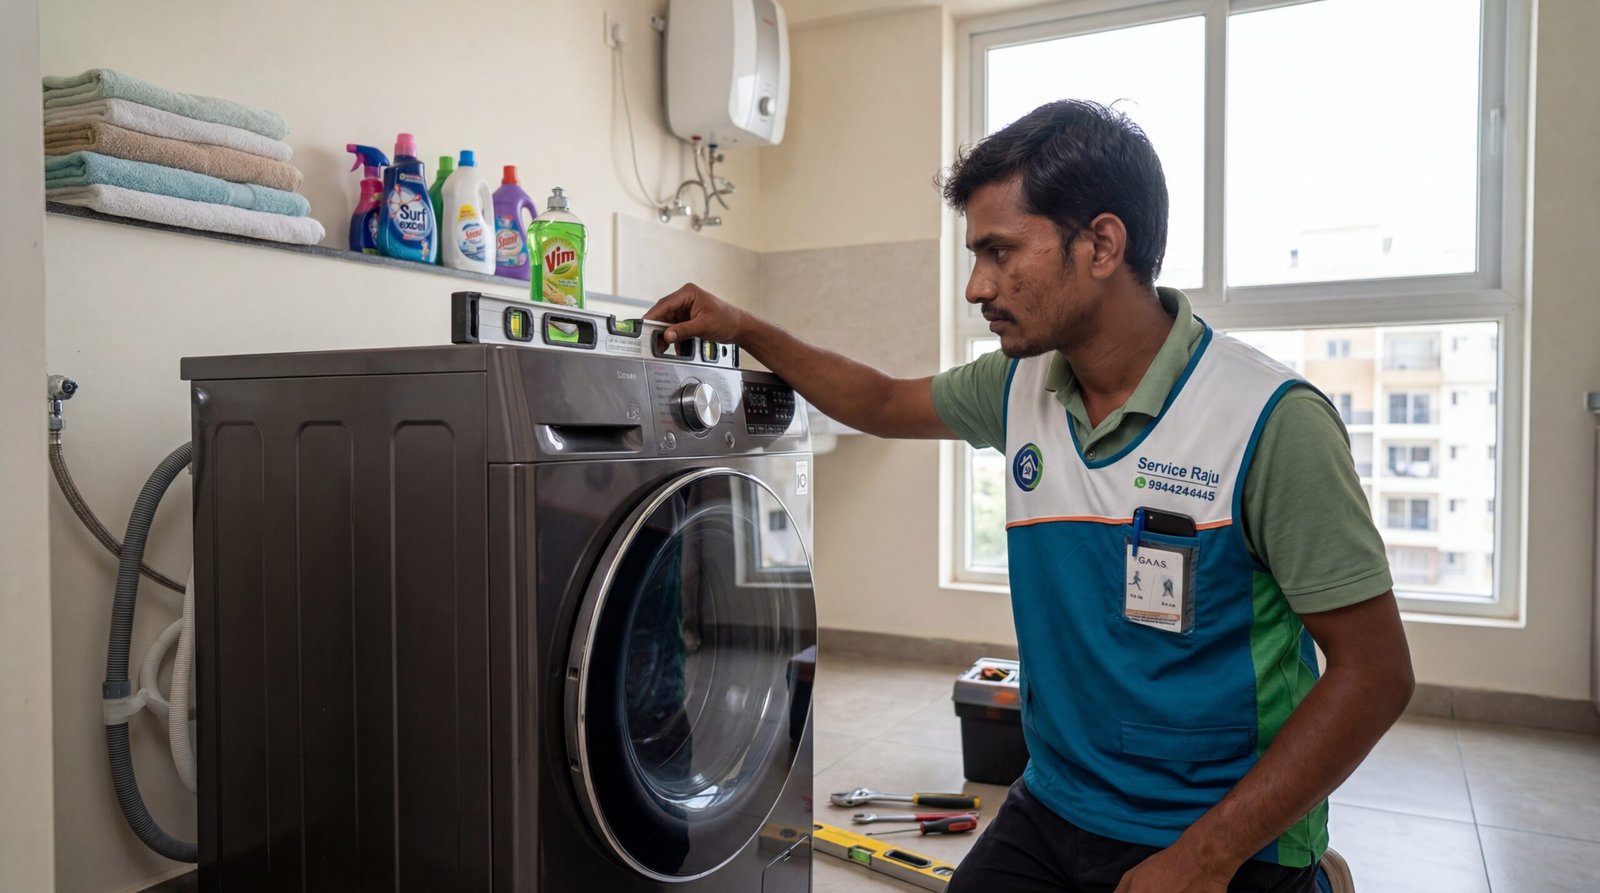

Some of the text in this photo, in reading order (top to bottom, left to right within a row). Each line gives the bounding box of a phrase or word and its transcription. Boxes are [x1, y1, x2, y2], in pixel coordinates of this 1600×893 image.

[400, 204, 427, 221] Surf
[399, 221, 426, 232] excel
[545, 246, 575, 273] Vim
[1138, 456, 1220, 486] Service Raju
